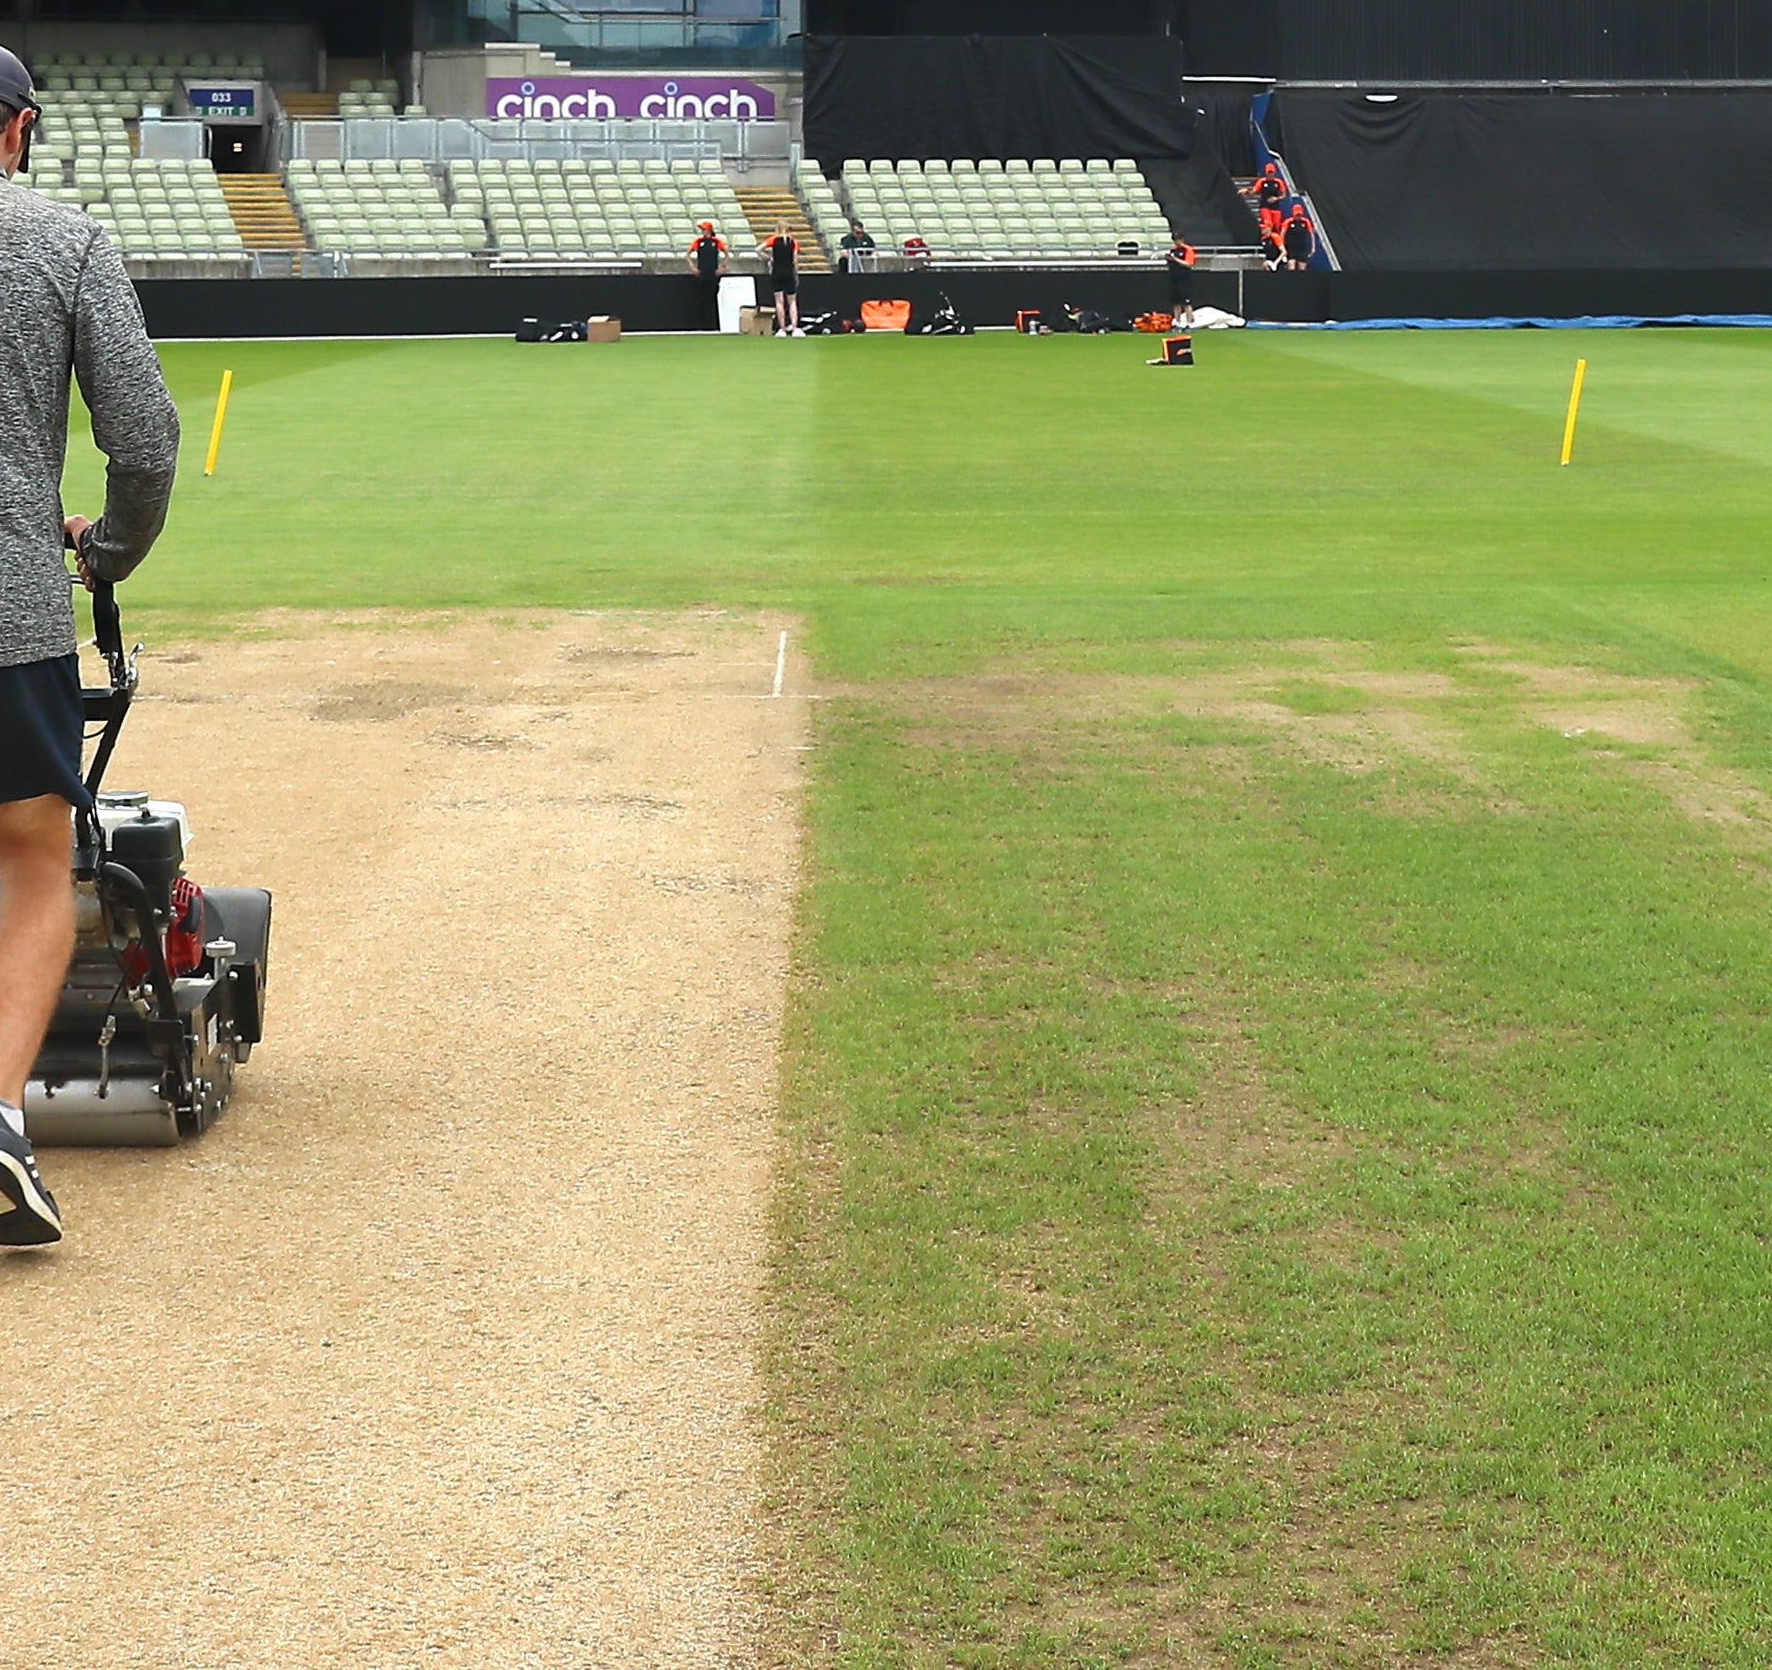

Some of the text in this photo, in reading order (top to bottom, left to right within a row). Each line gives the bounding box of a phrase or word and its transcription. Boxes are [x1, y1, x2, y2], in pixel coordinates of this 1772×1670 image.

[211, 92, 232, 103] 033
[497, 81, 758, 118] cinch cinch
[208, 106, 234, 116] EXIT
